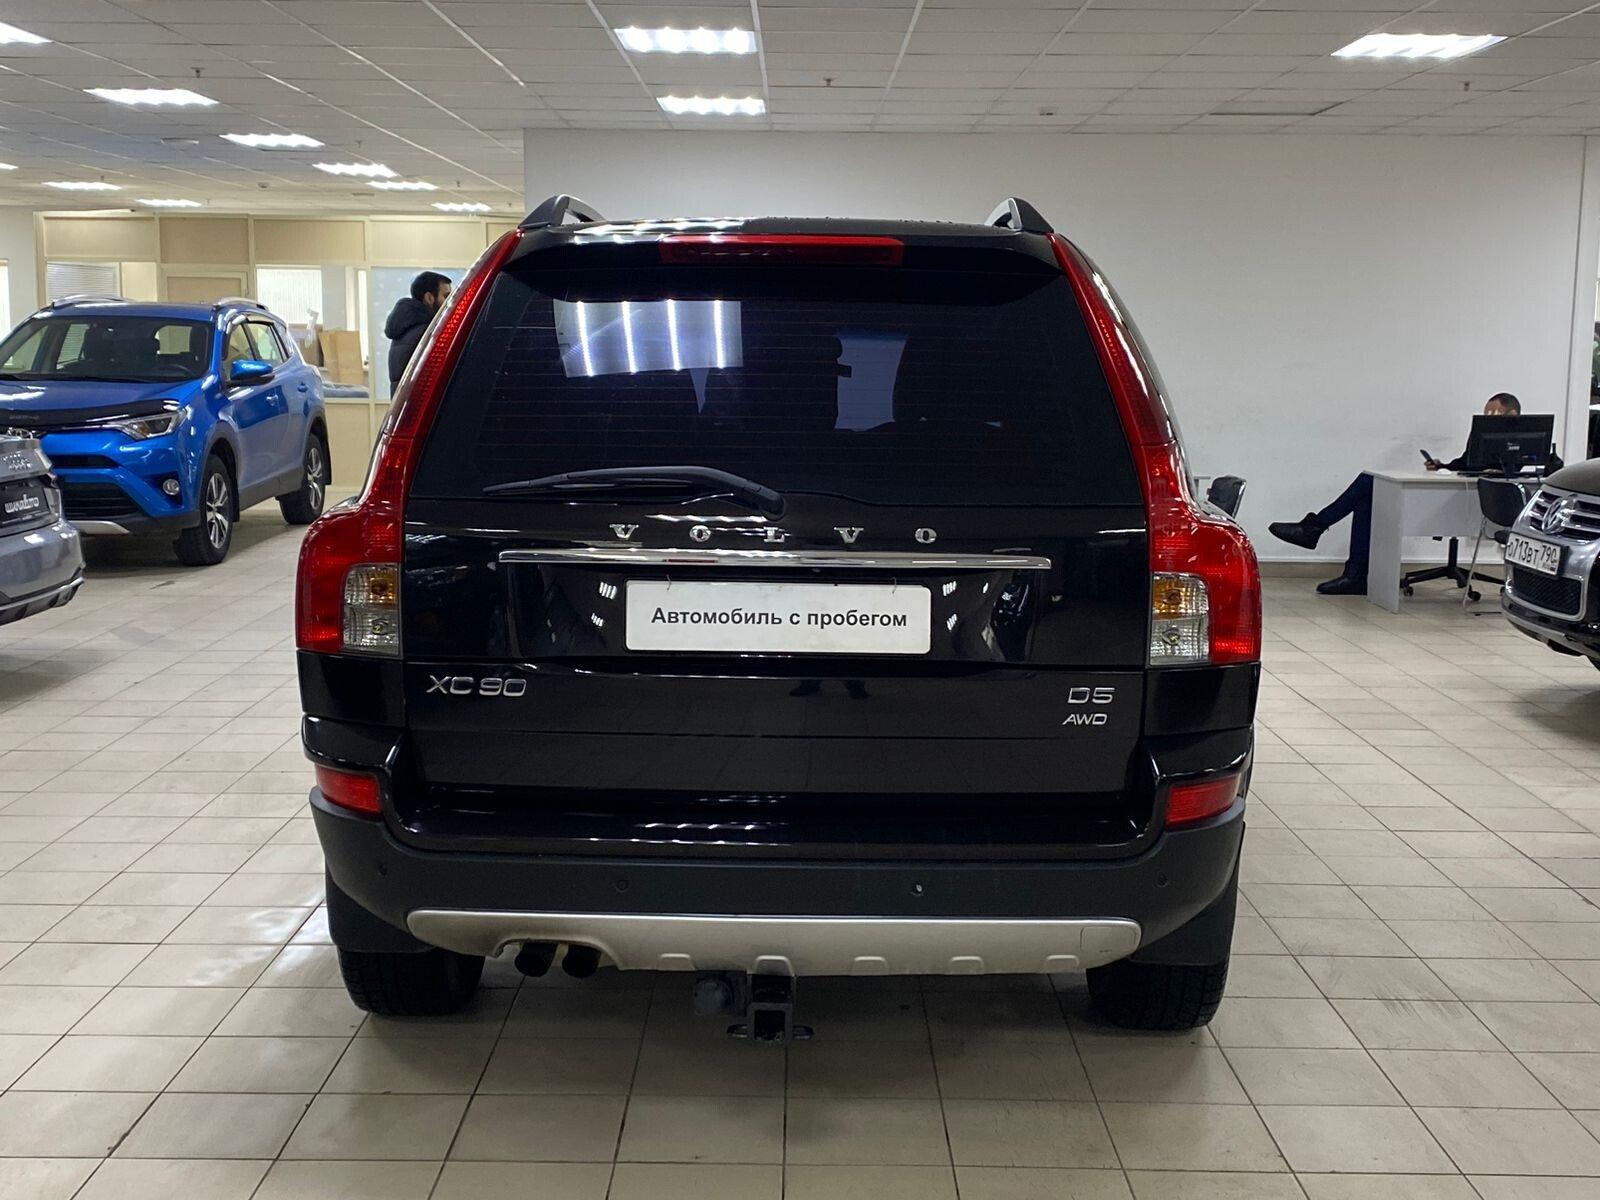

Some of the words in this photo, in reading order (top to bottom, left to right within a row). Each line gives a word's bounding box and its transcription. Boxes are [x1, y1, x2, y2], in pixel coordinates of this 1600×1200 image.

[609, 524, 937, 545] VOLVO
[651, 607, 782, 625] Автомобиль
[789, 612, 801, 625] с
[807, 609, 907, 629] пробегом
[1067, 687, 1115, 704] D5
[1062, 713, 1108, 725] AWD
